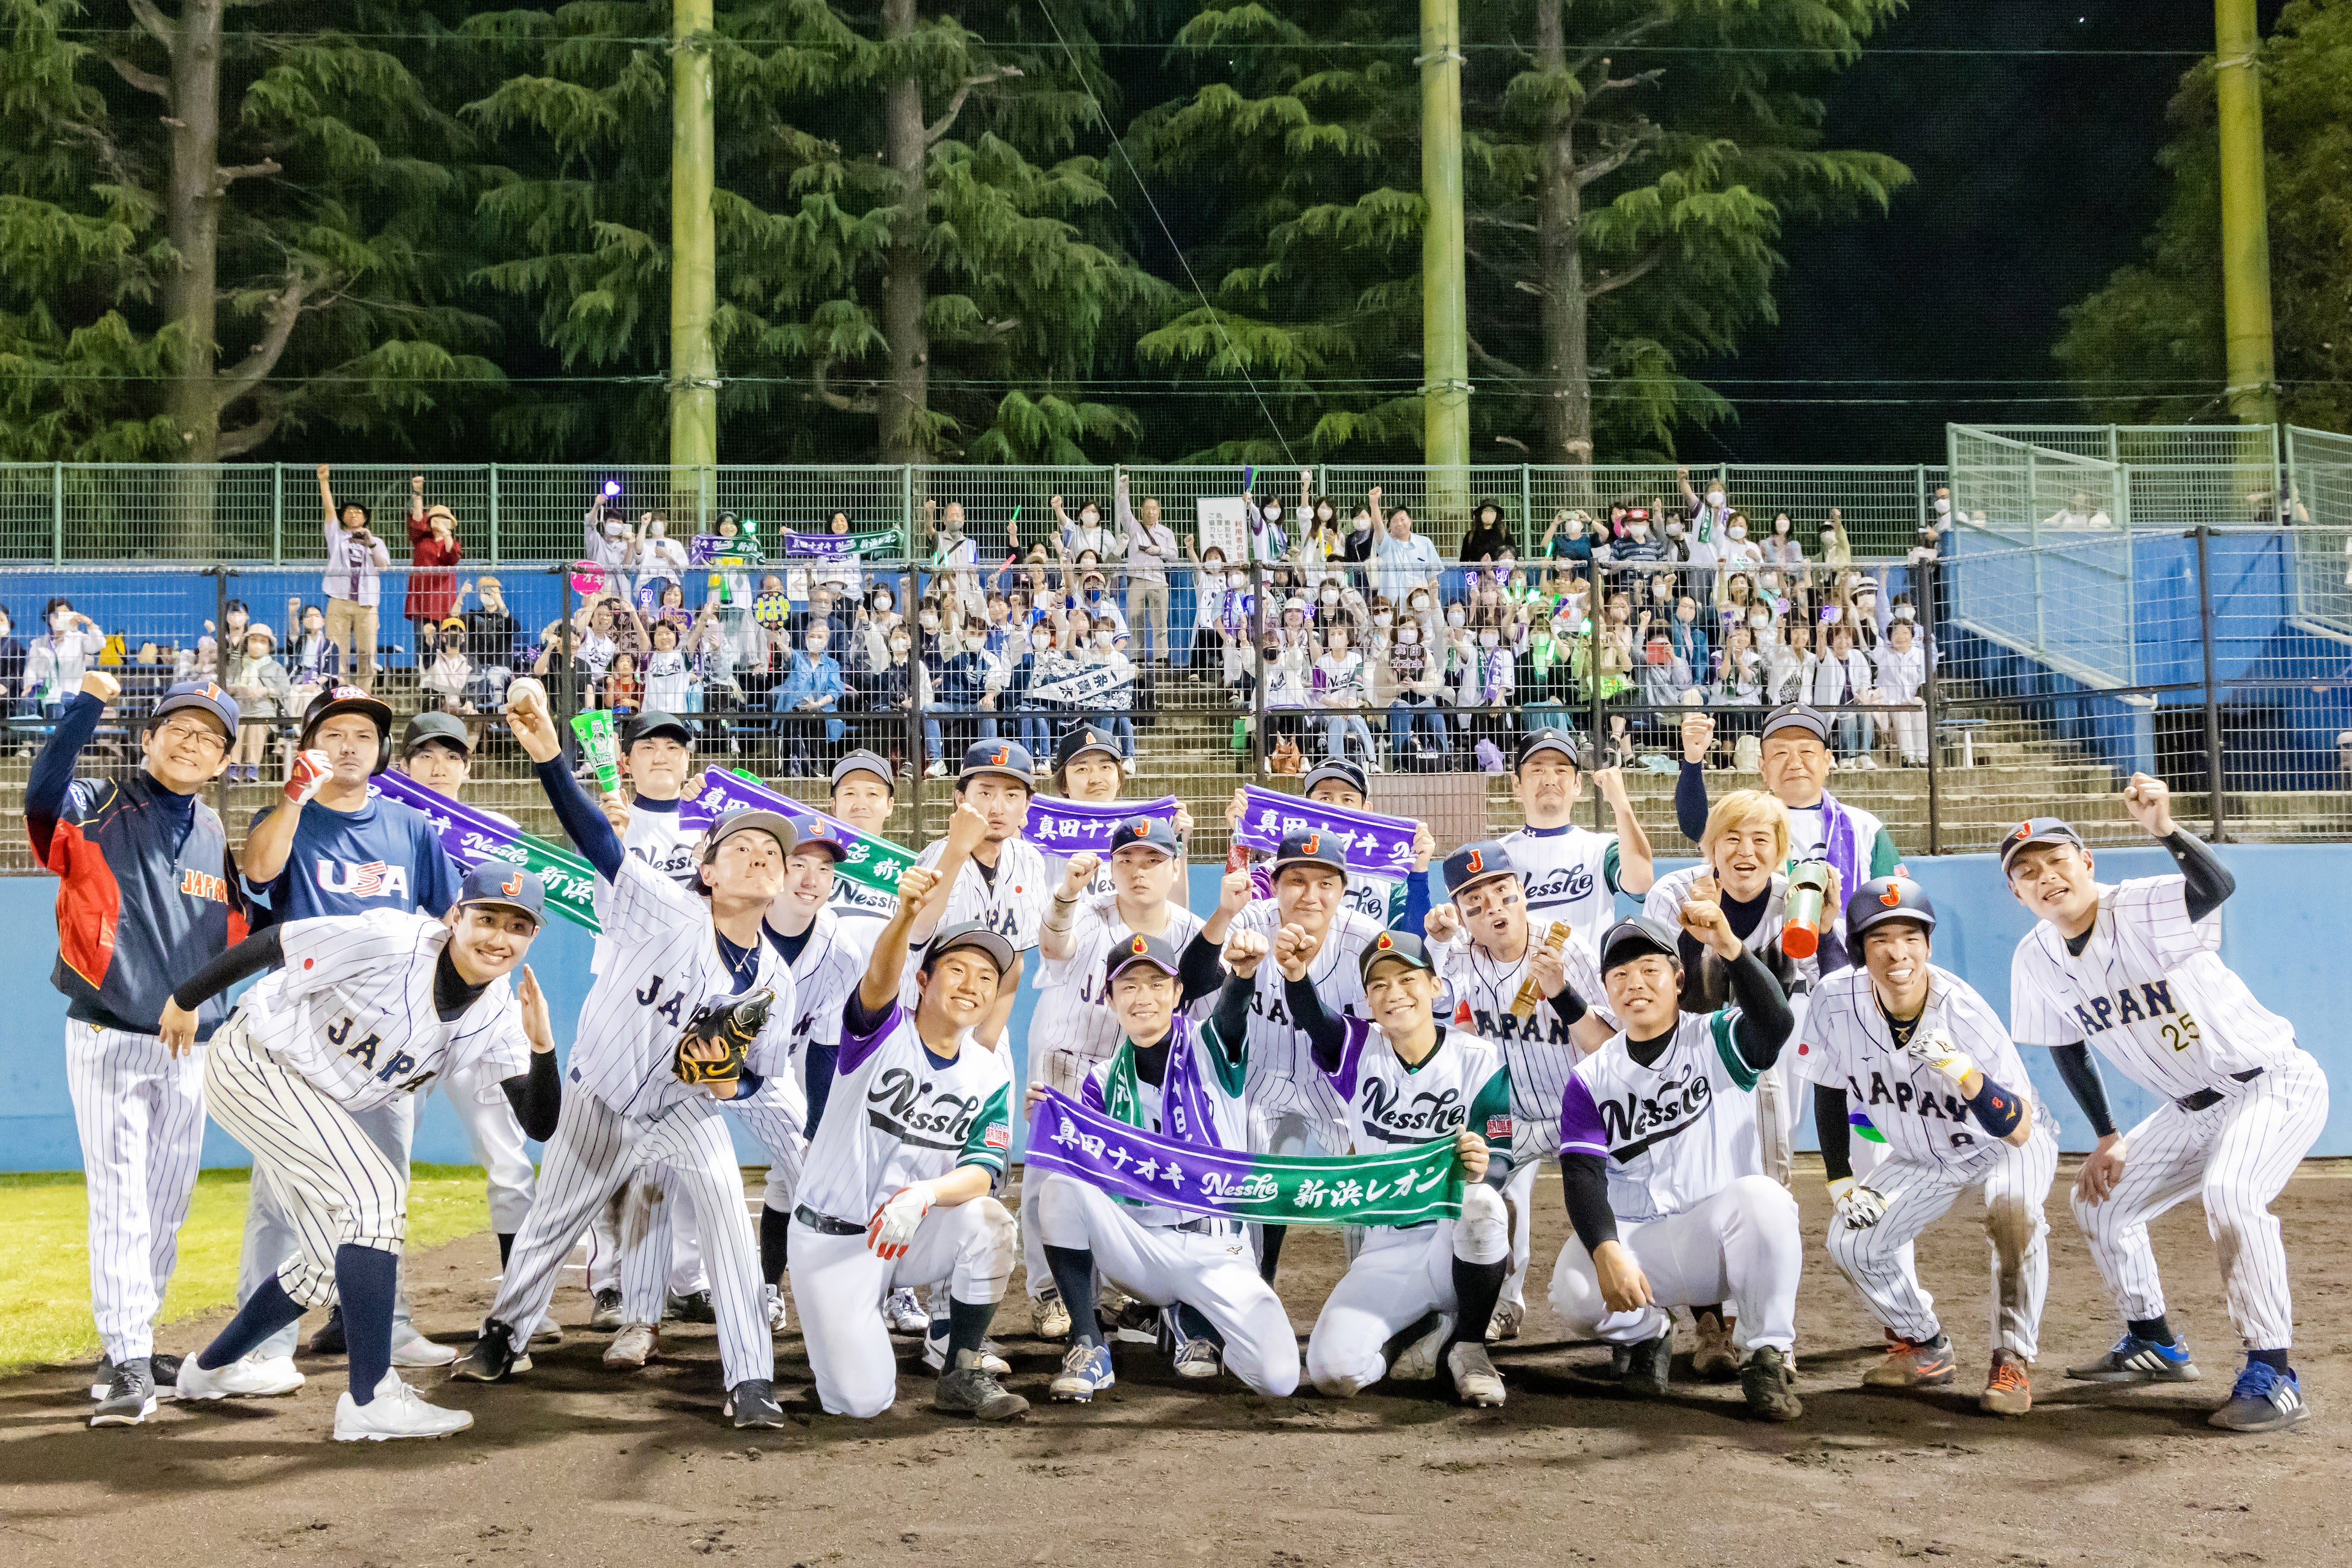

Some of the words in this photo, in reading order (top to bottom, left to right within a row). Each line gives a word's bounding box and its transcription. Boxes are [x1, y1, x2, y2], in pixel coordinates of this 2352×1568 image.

[991, 745, 1008, 765] J
[809, 817, 824, 835] J
[1134, 819, 1151, 837] J
[2015, 819, 2034, 840] J
[1301, 834, 1320, 855] J
[1467, 849, 1484, 873] J
[317, 861, 409, 899] USA
[502, 871, 523, 896] J
[1523, 863, 1593, 900] essho
[1880, 884, 1900, 906] J
[1362, 1076, 1465, 1134] Nessho
[1051, 1116, 1186, 1190] 真田ナオキ
[1200, 1173, 1279, 1203] Nessho
[1292, 1168, 1447, 1210] 新浜レオン
